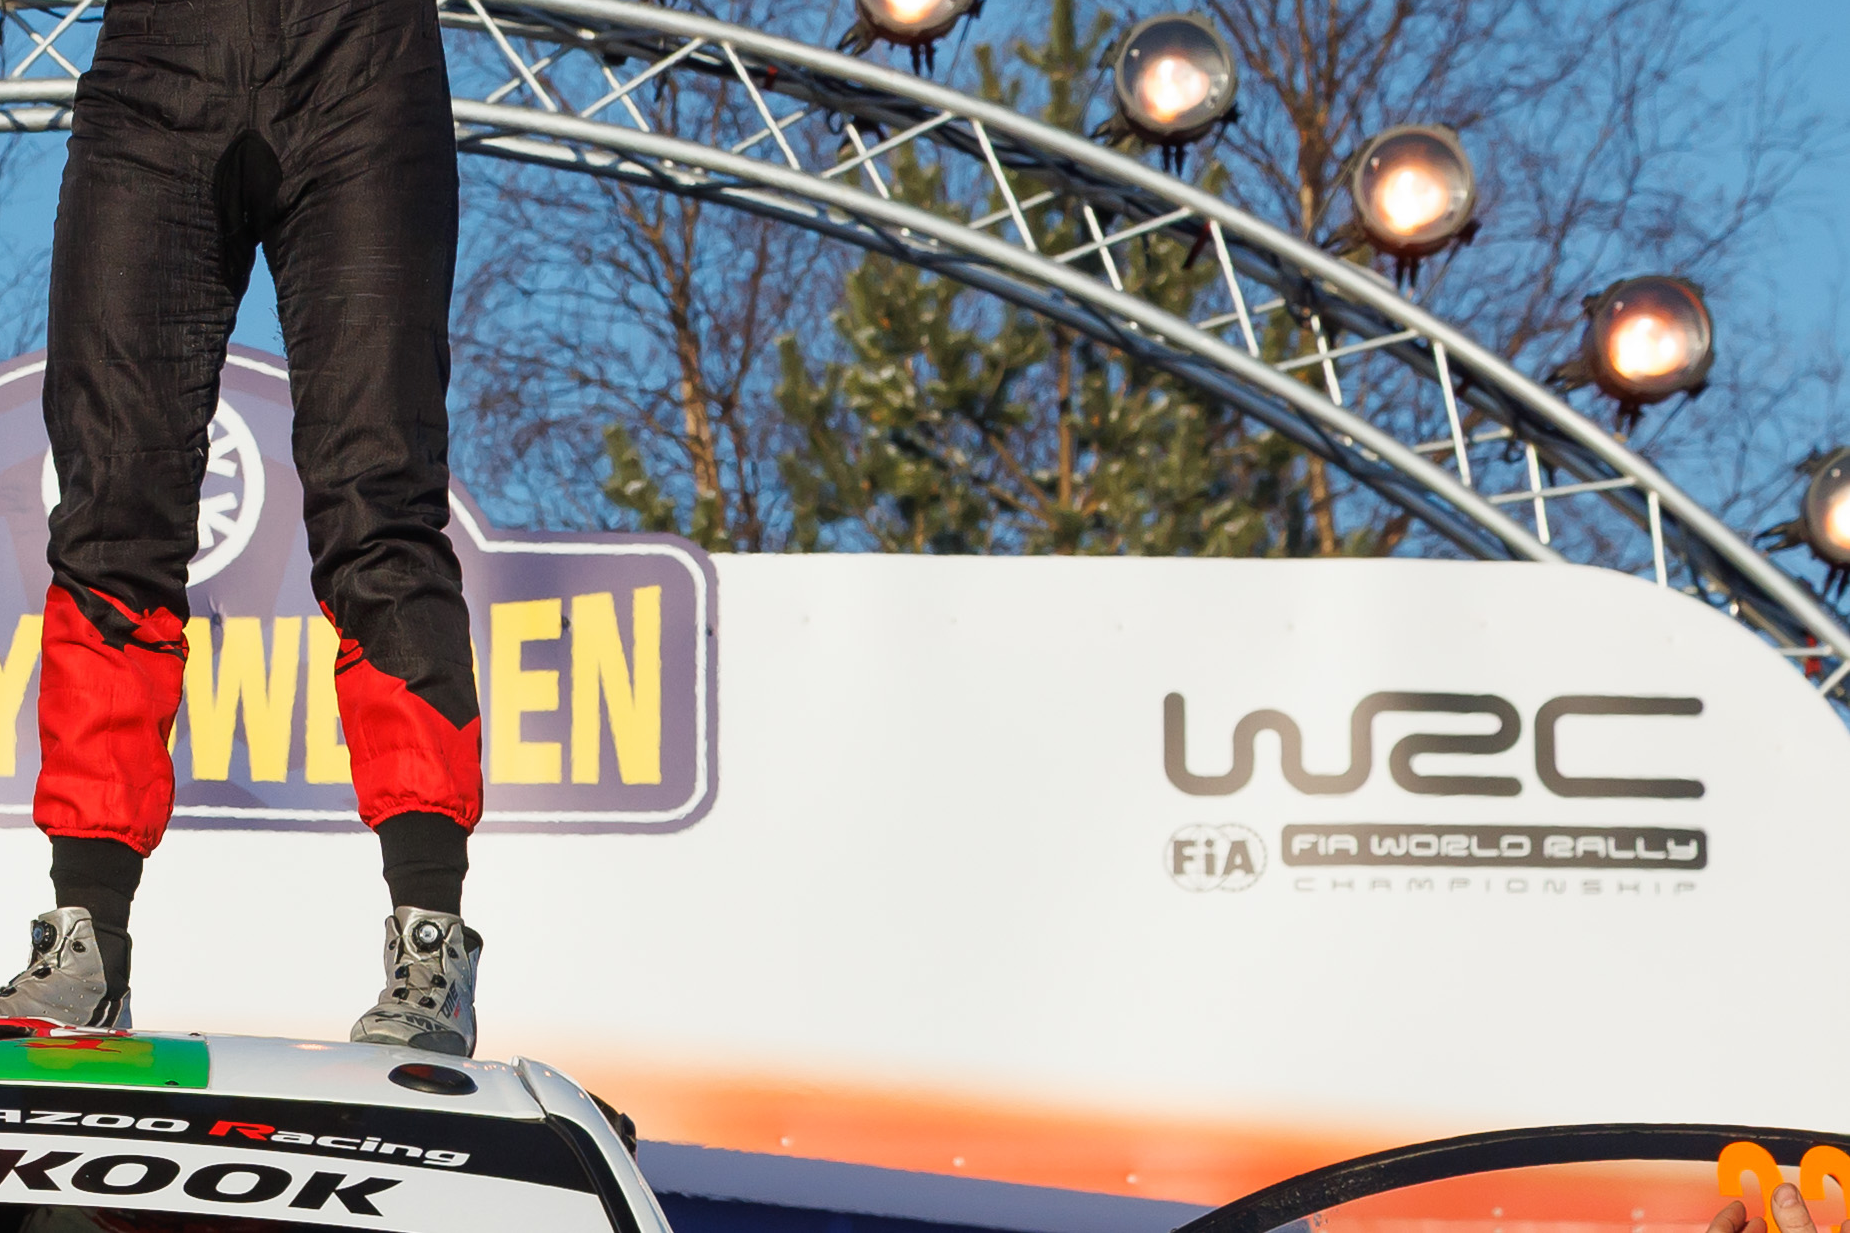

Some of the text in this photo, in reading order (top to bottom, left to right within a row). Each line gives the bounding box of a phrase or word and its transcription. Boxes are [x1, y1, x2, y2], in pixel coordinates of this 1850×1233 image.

[1164, 692, 1705, 798] WRC
[1291, 834, 1698, 860] FIA WORLD RALLY
[1294, 878, 1696, 894] CHAMPIONSHIP
[208, 1120, 470, 1167] Racing
